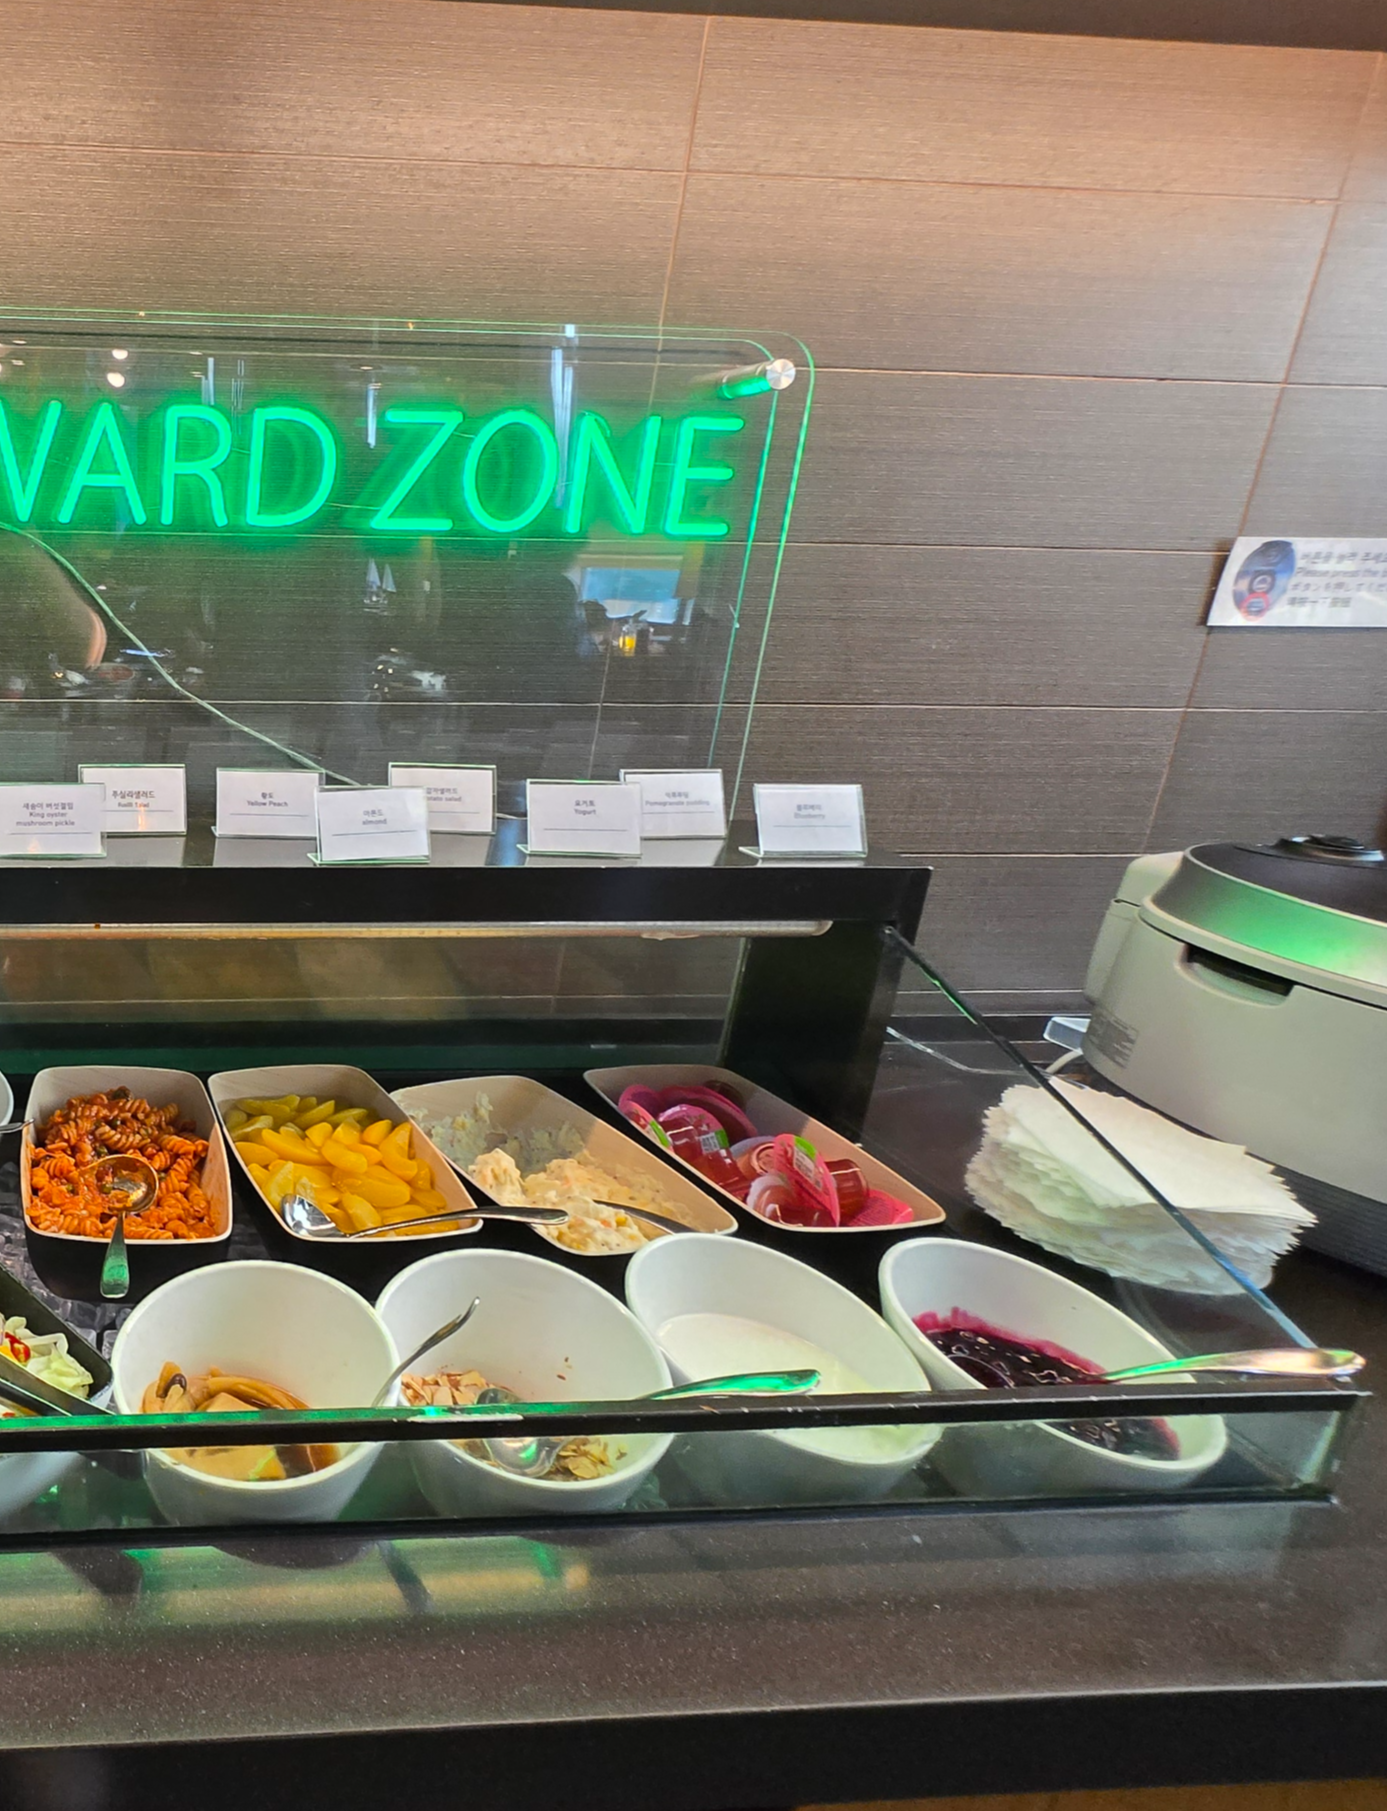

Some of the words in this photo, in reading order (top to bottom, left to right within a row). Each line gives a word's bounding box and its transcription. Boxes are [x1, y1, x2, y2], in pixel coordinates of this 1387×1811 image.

[371, 409, 745, 536] ZONE
[268, 800, 289, 808] Peach
[29, 811, 45, 819] King
[46, 811, 68, 819] oyster
[363, 809, 384, 818] 아몬드
[574, 808, 597, 816] Yogurt
[54, 819, 75, 827] pickle
[362, 818, 388, 826] almond
